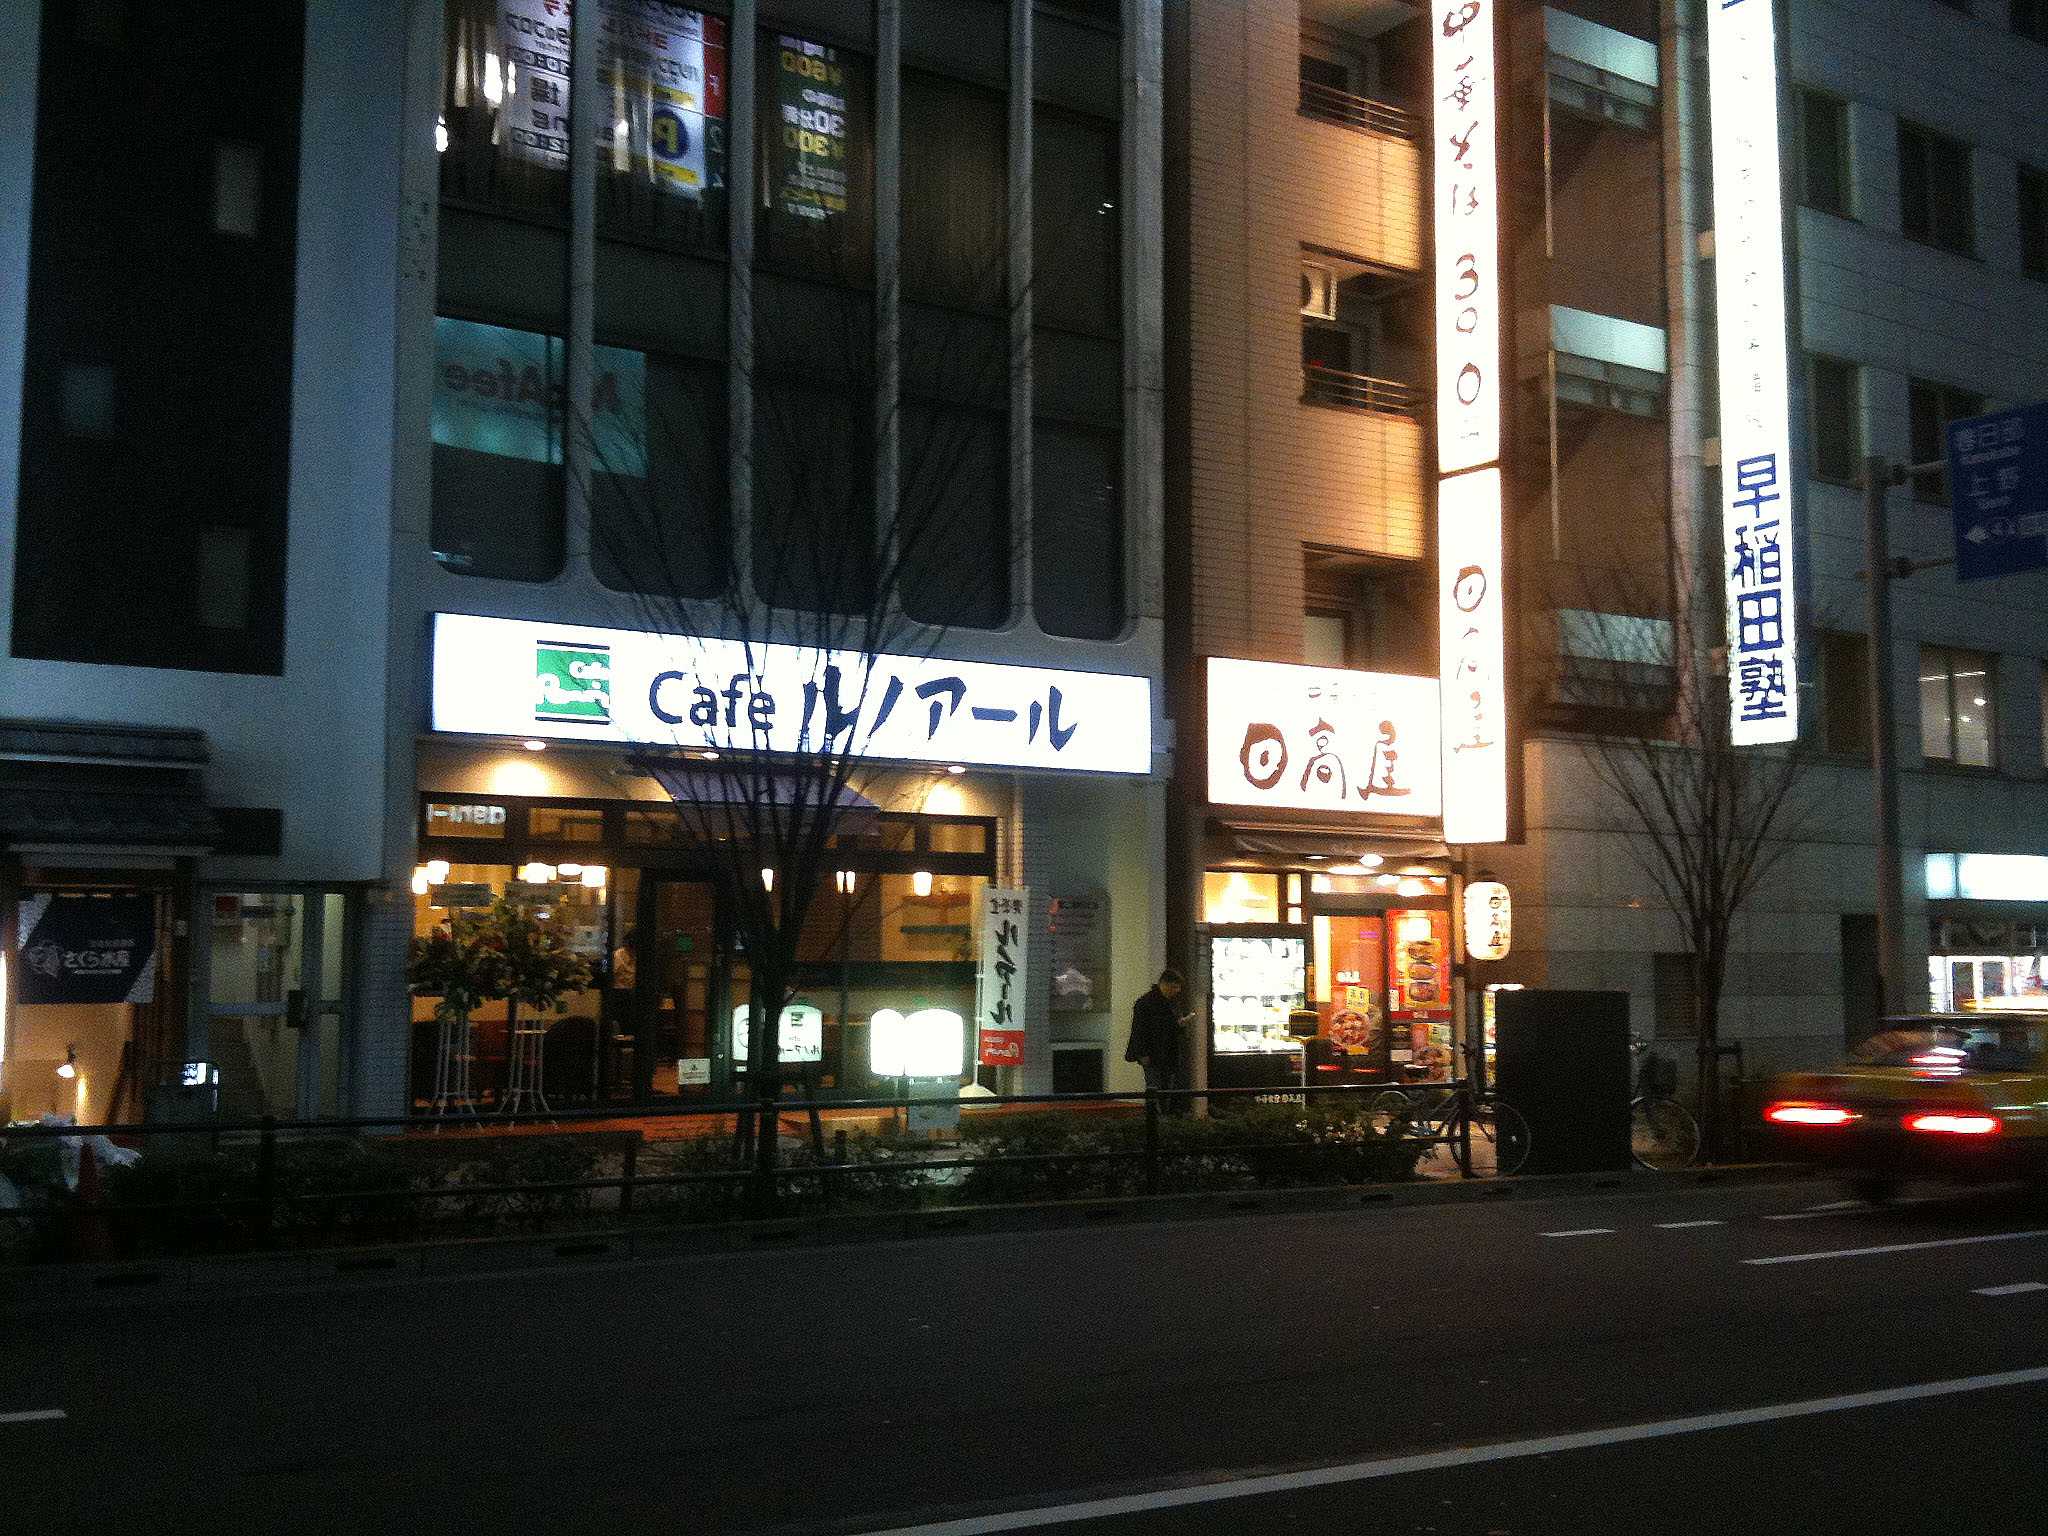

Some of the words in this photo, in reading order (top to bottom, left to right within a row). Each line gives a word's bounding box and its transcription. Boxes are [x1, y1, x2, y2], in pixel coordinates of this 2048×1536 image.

[1732, 453, 1787, 721] 早稲田塾
[803, 664, 1078, 752] ルノアール
[1239, 716, 1412, 801] 日高屋
